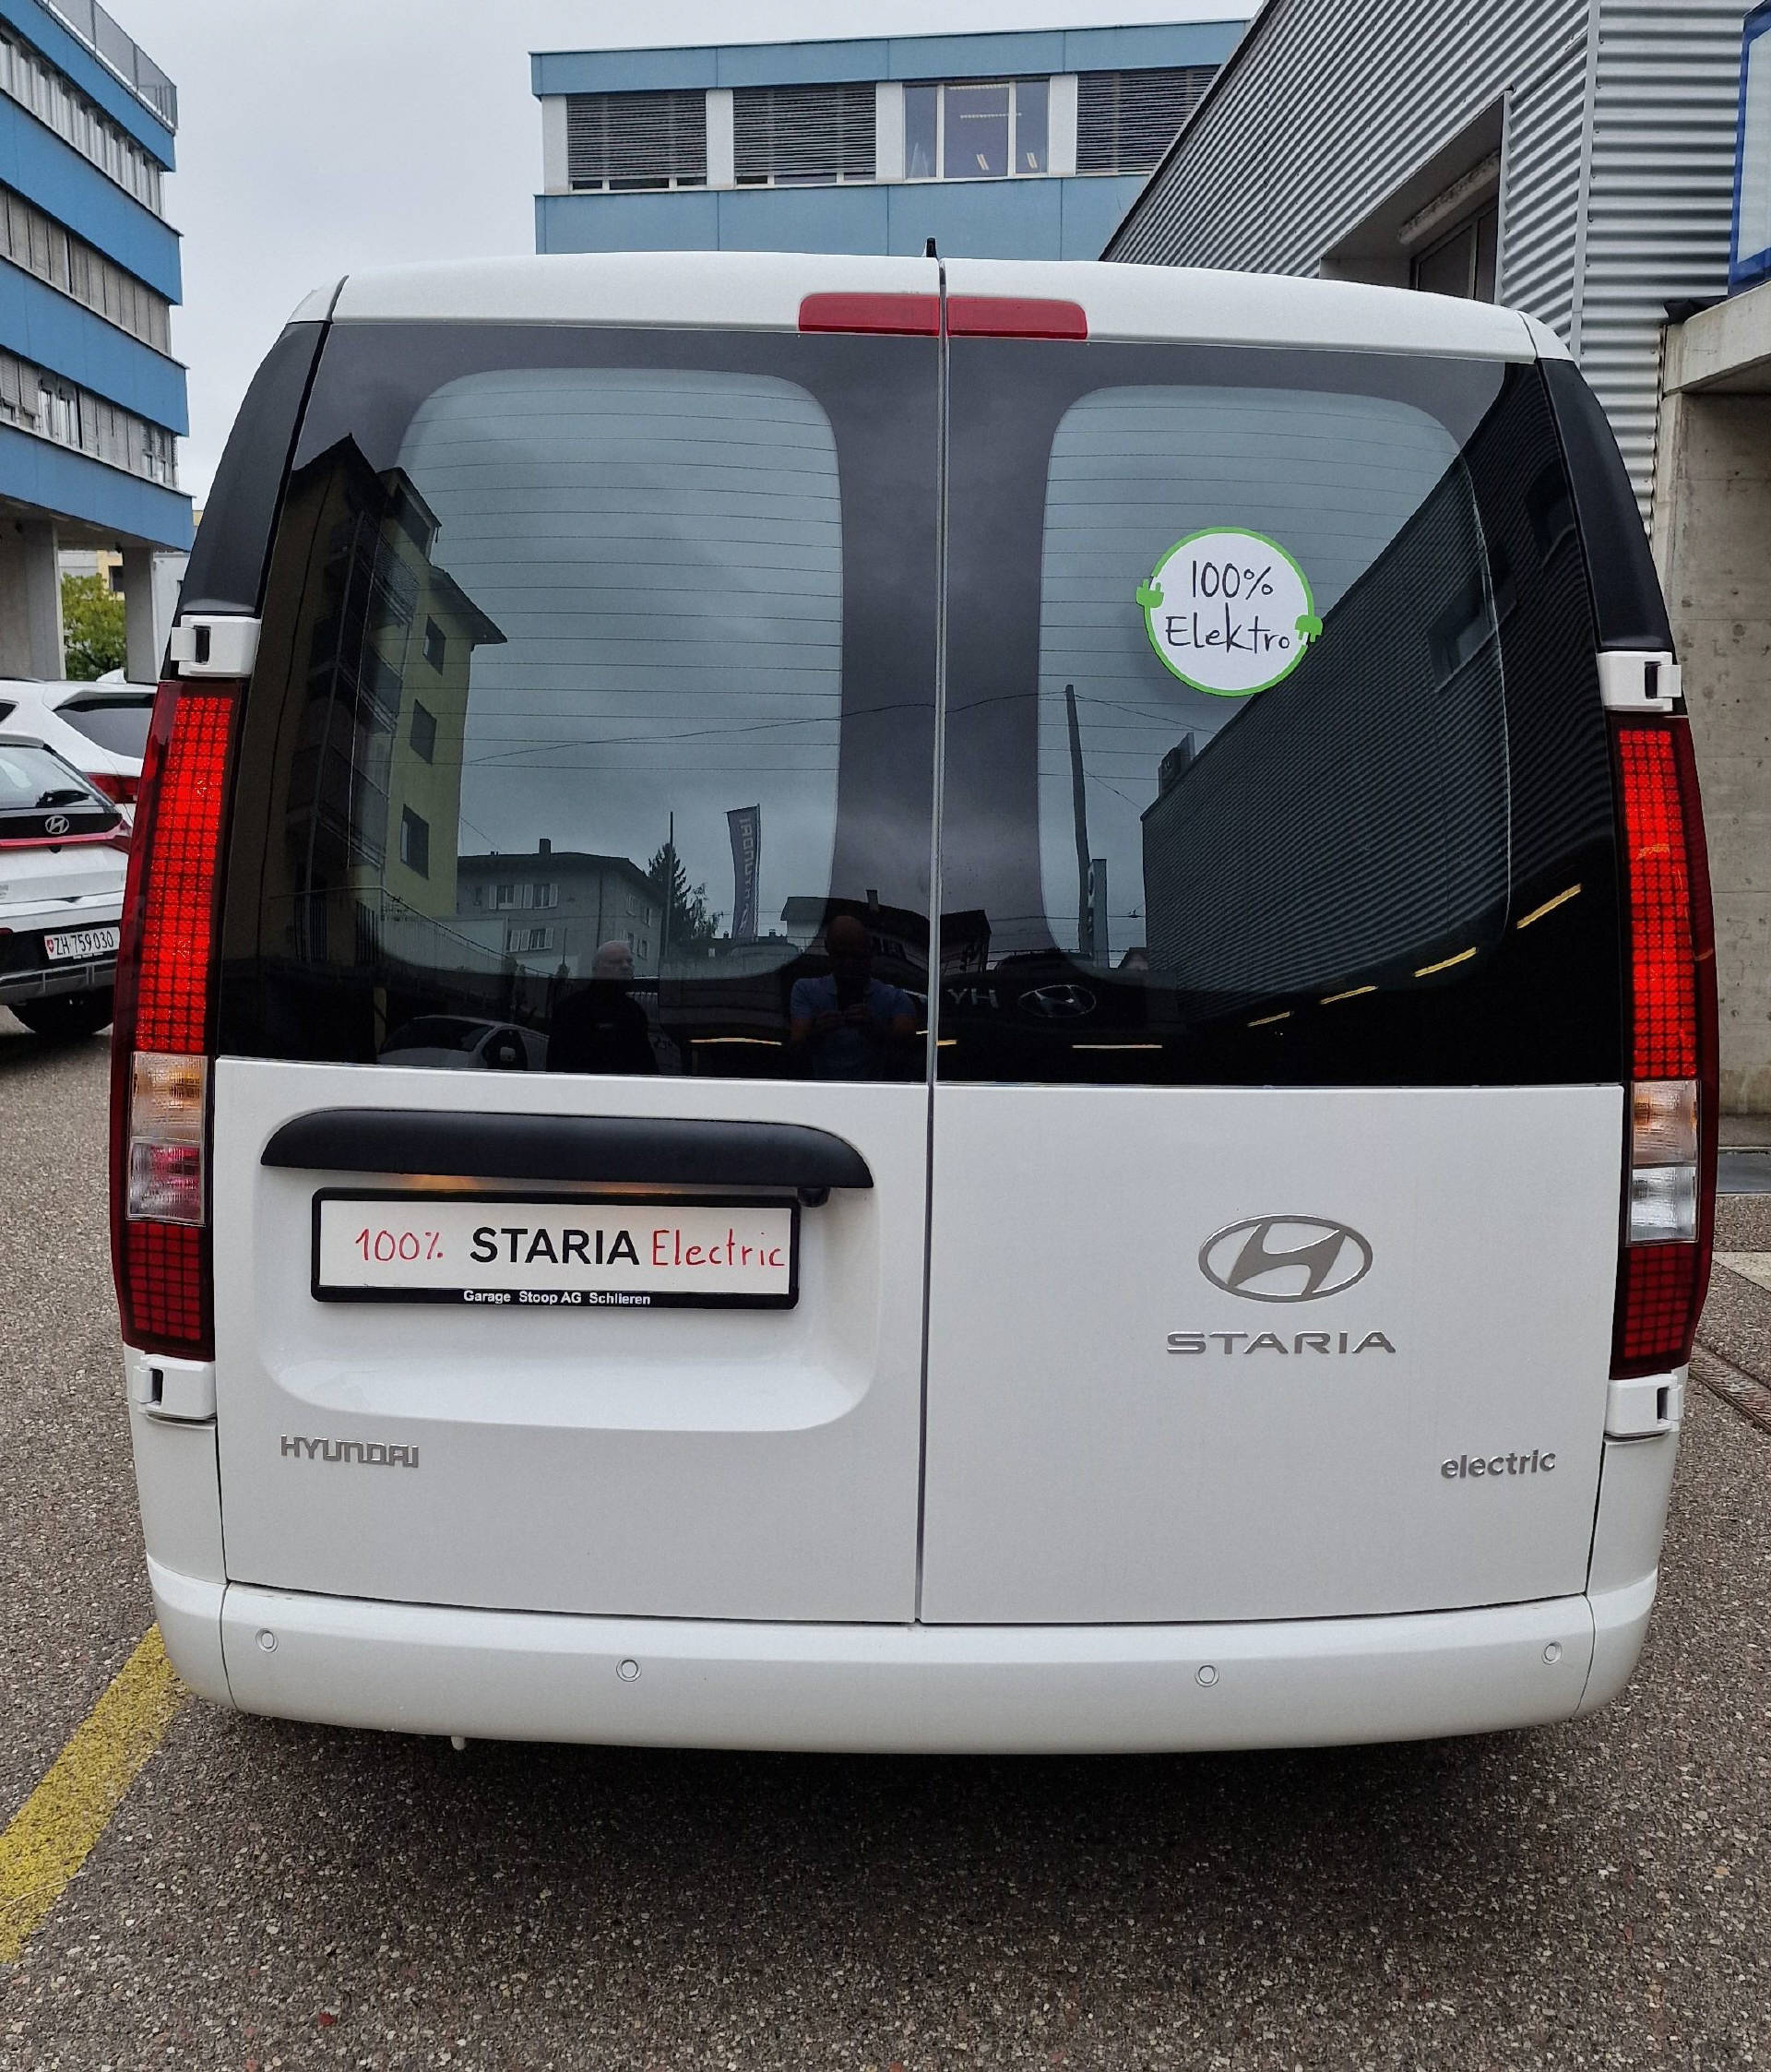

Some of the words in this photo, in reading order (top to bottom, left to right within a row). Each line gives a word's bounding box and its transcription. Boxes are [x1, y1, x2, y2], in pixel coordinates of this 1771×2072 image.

[1192, 560, 1274, 600] 100%
[1165, 602, 1290, 653] Elektro
[55, 936, 69, 956] ZH
[355, 1228, 444, 1261] 100%
[469, 1227, 640, 1265] STARIA
[651, 1228, 785, 1267] Electric
[463, 1290, 512, 1304] Garage
[518, 1291, 558, 1305] Stoop
[560, 1292, 582, 1304] AG
[1166, 1330, 1397, 1354] STARIA
[280, 1434, 419, 1468] HYUNDAI
[1441, 1448, 1556, 1479] electric
